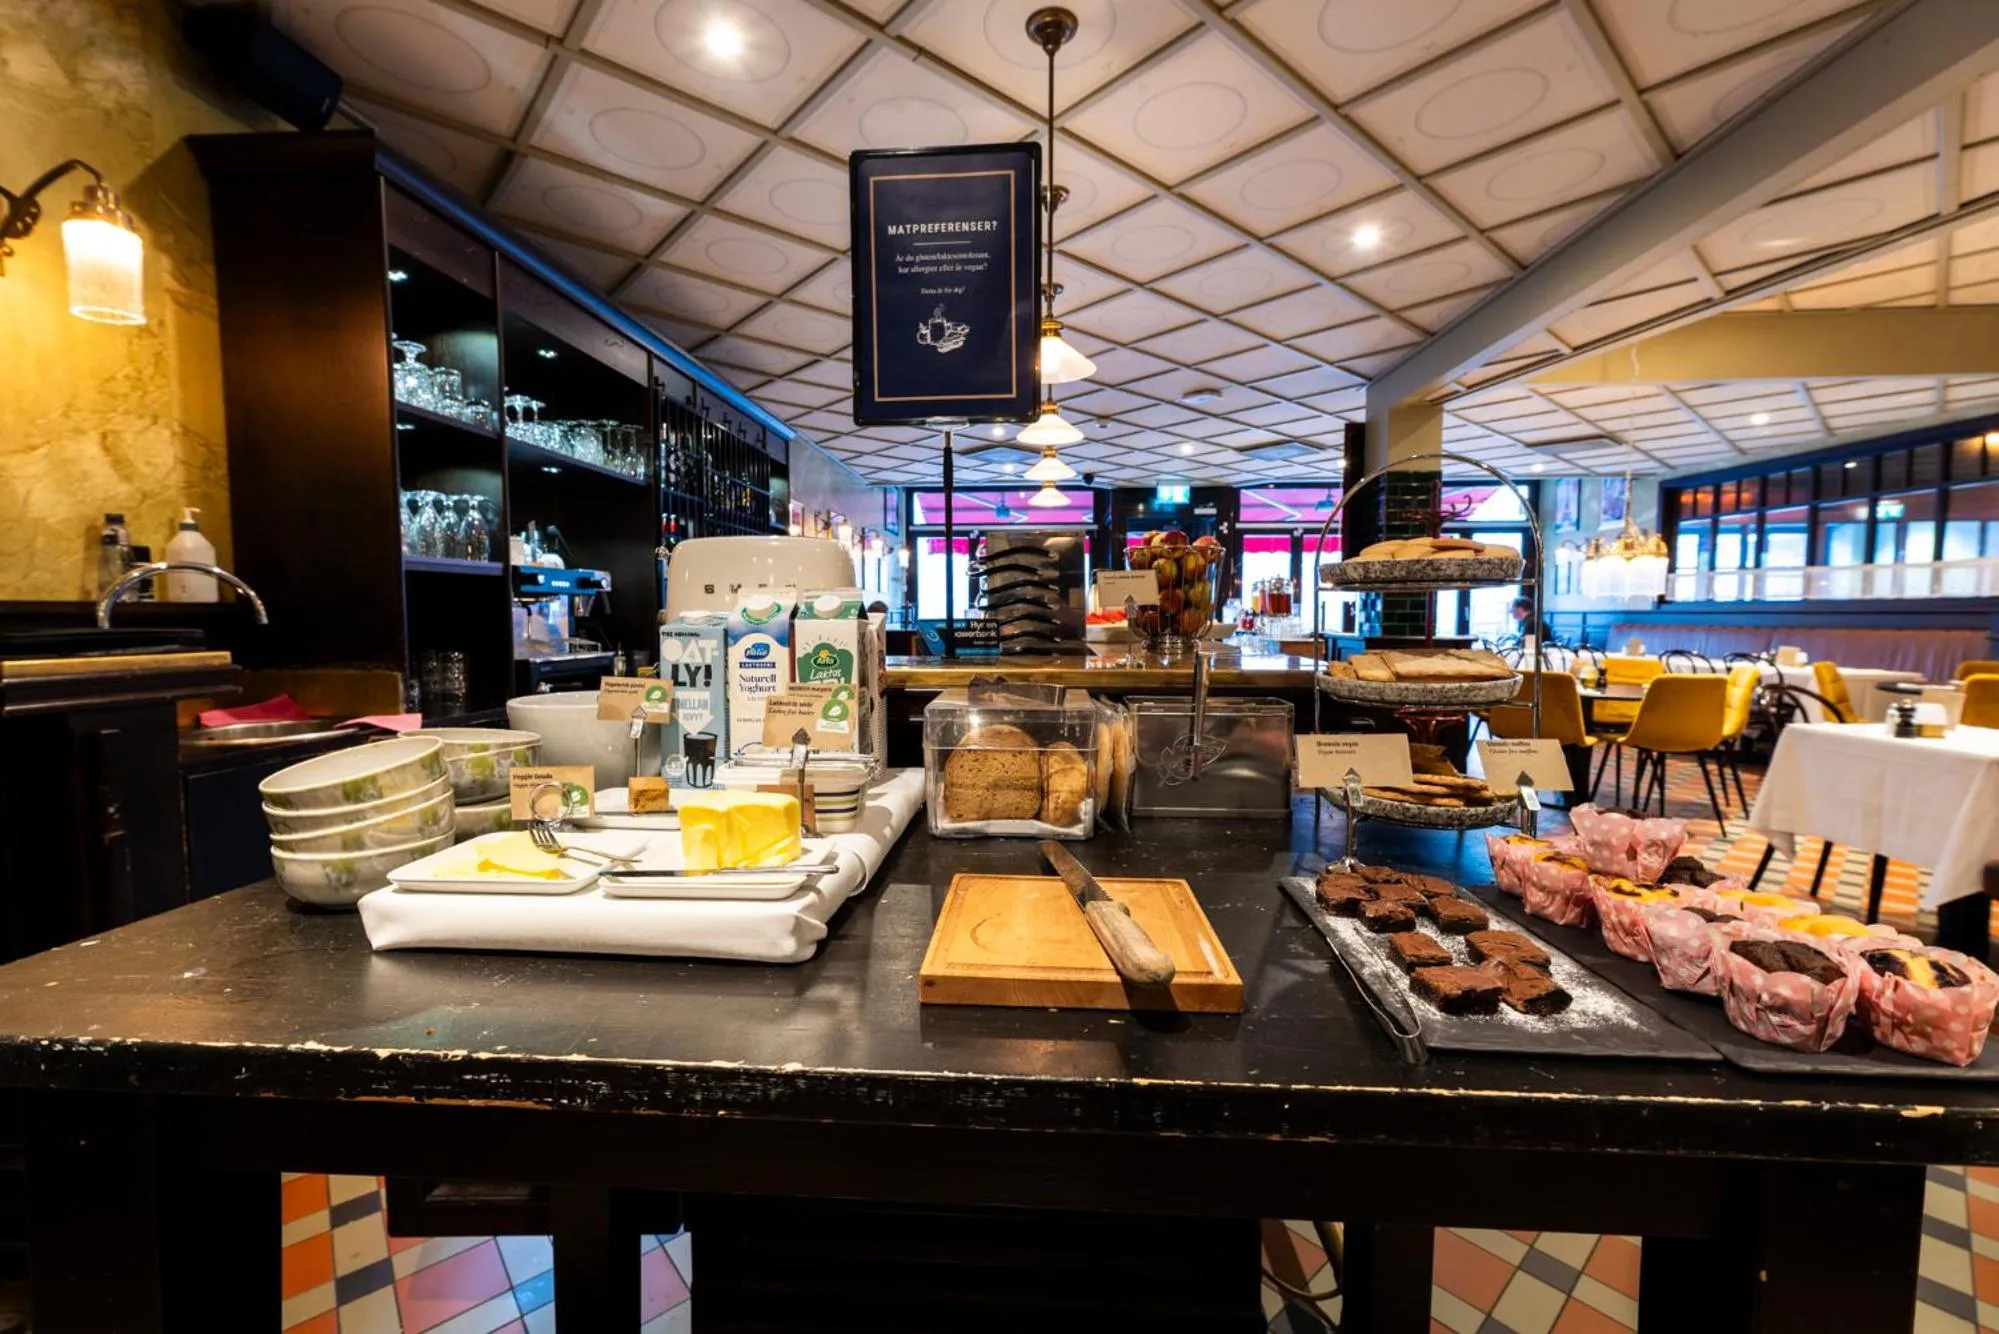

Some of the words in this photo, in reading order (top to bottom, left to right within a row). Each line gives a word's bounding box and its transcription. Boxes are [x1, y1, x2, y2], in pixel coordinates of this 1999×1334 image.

[888, 221, 997, 235] MATPREFERENSER?
[671, 663, 713, 688] LY!
[739, 674, 776, 683] Naturell
[739, 683, 776, 693] Yoghurt
